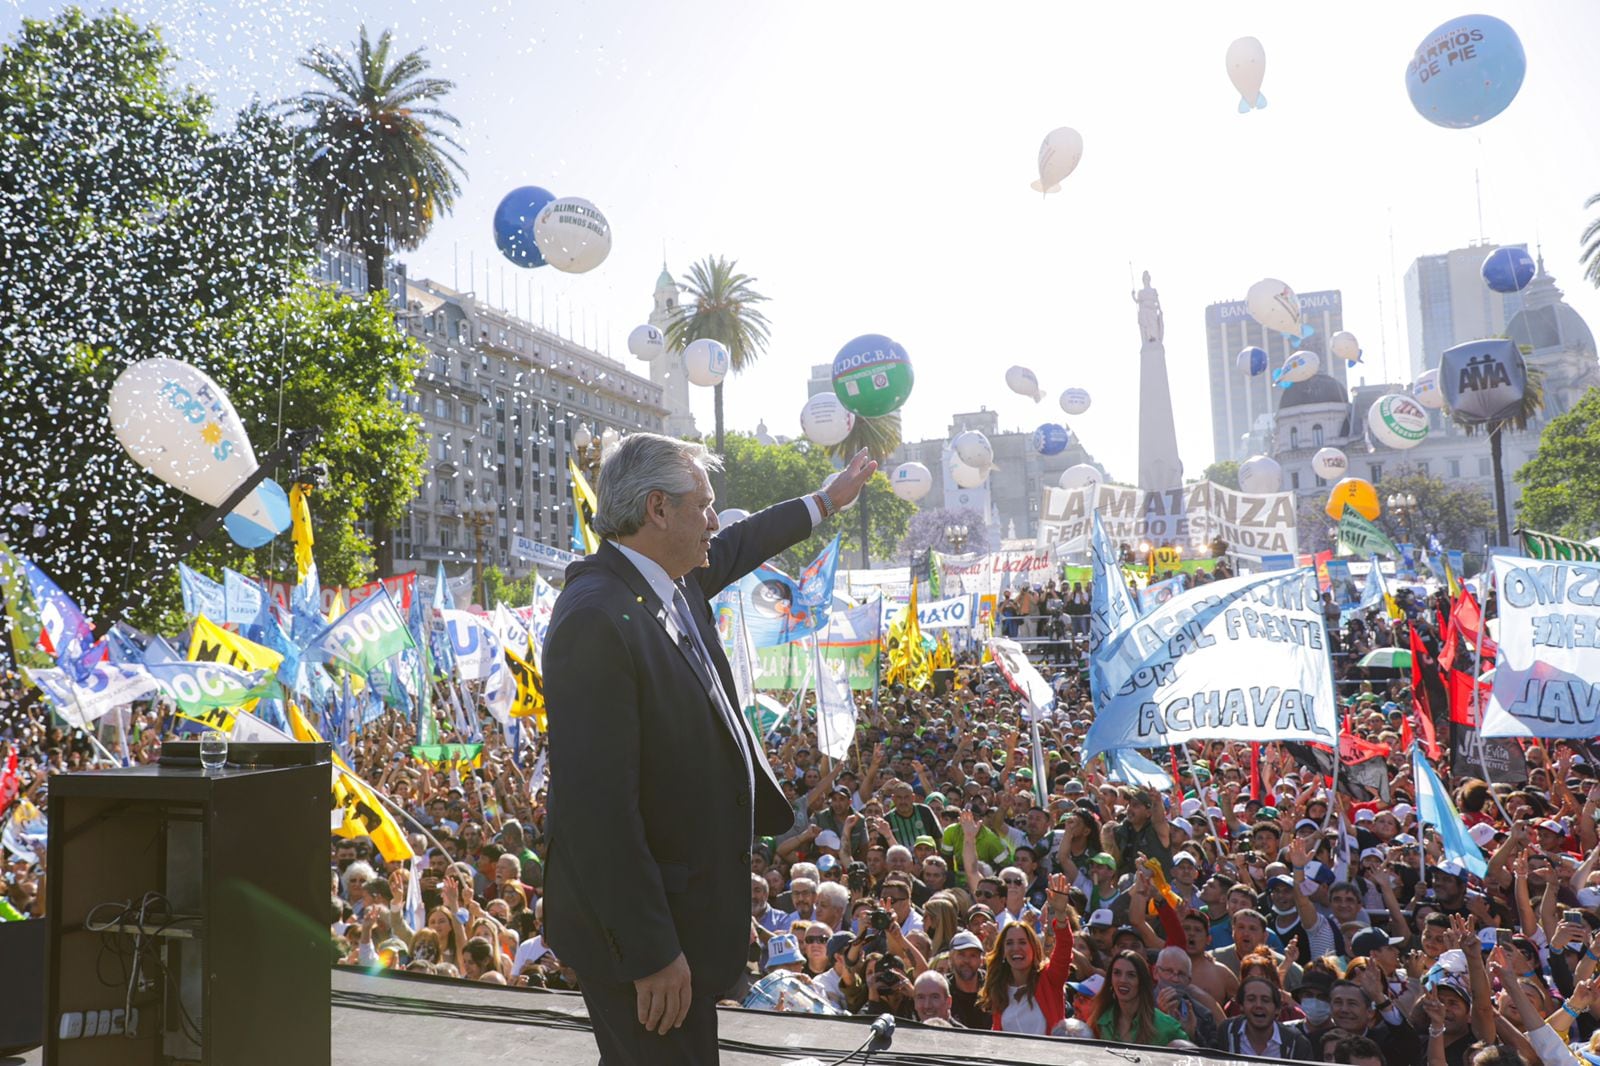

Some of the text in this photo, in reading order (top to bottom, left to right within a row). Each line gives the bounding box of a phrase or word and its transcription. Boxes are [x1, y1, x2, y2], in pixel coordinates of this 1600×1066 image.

[1410, 28, 1484, 75] BARRIOS
[1419, 44, 1477, 83] DE PIE
[553, 203, 606, 226] ALIMETACI
[559, 215, 586, 228] BUENOS
[1221, 305, 1249, 319] BAN
[1459, 362, 1512, 394] AMA
[1040, 481, 1296, 529] LA MATANZA
[1176, 516, 1288, 553] ESPINOZA
[993, 551, 1049, 574] Lealtad
[1225, 606, 1322, 650] FRENTE
[1138, 686, 1332, 738] ACHAVAL
